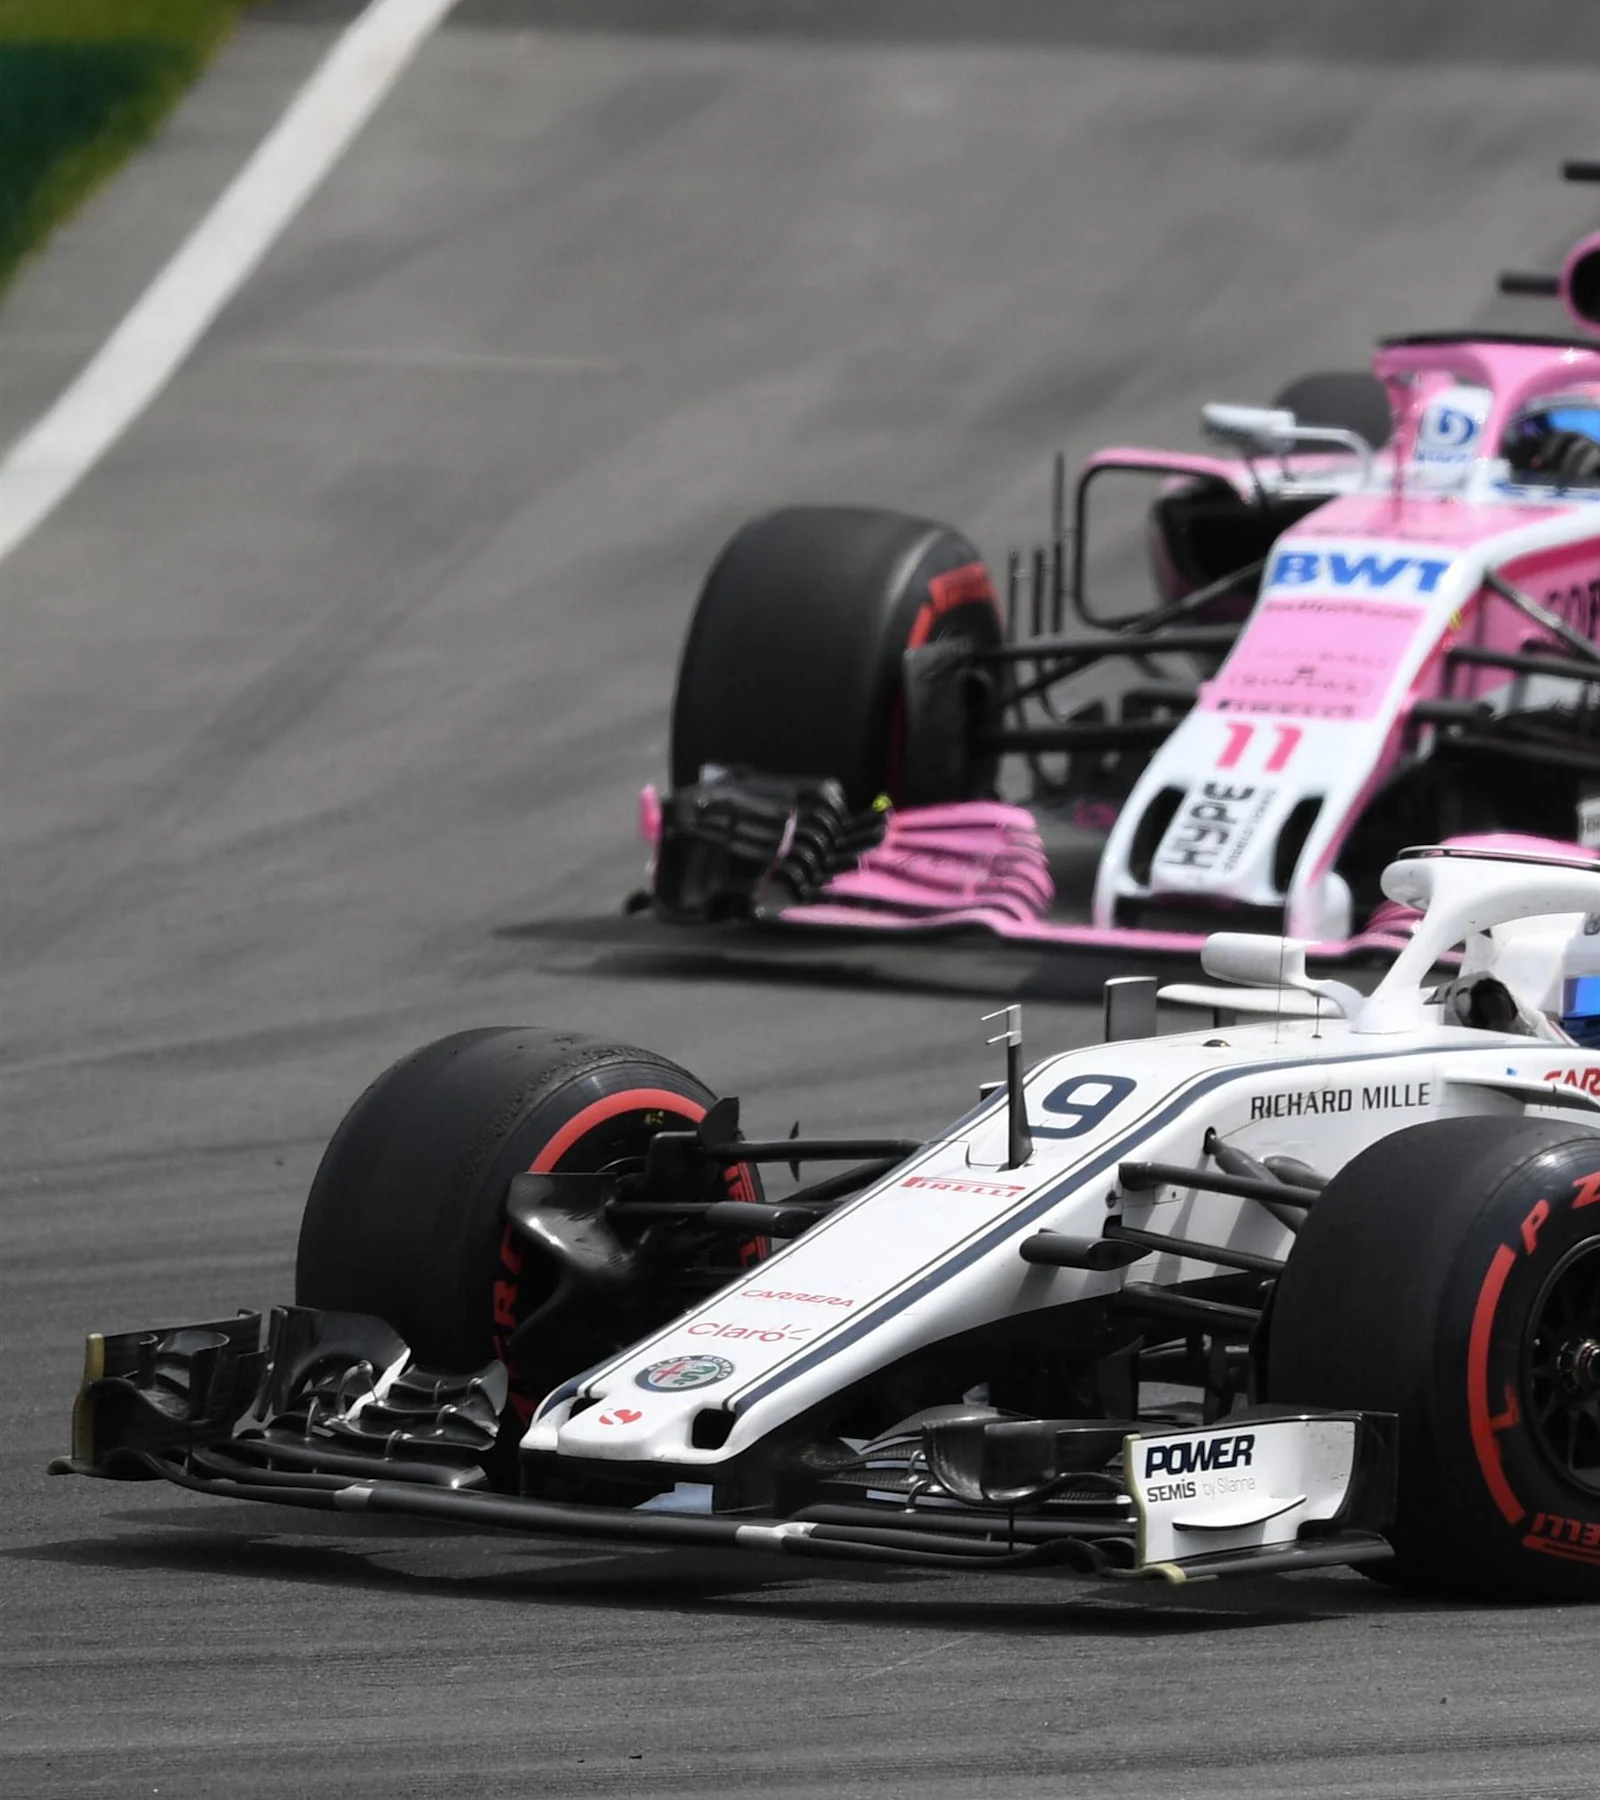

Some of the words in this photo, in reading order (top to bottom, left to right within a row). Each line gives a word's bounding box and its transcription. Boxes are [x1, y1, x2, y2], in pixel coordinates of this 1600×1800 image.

[1271, 553, 1454, 593] BWT
[1214, 721, 1305, 772] 11
[1030, 1074, 1138, 1140] 9
[1250, 1088, 1352, 1121] RICHARD
[1362, 1083, 1431, 1110] MILLE
[899, 1176, 1027, 1199] PIRELLI
[1520, 1199, 1550, 1255] P
[740, 1289, 855, 1308] CARRERA
[1144, 1433, 1256, 1480] POWER
